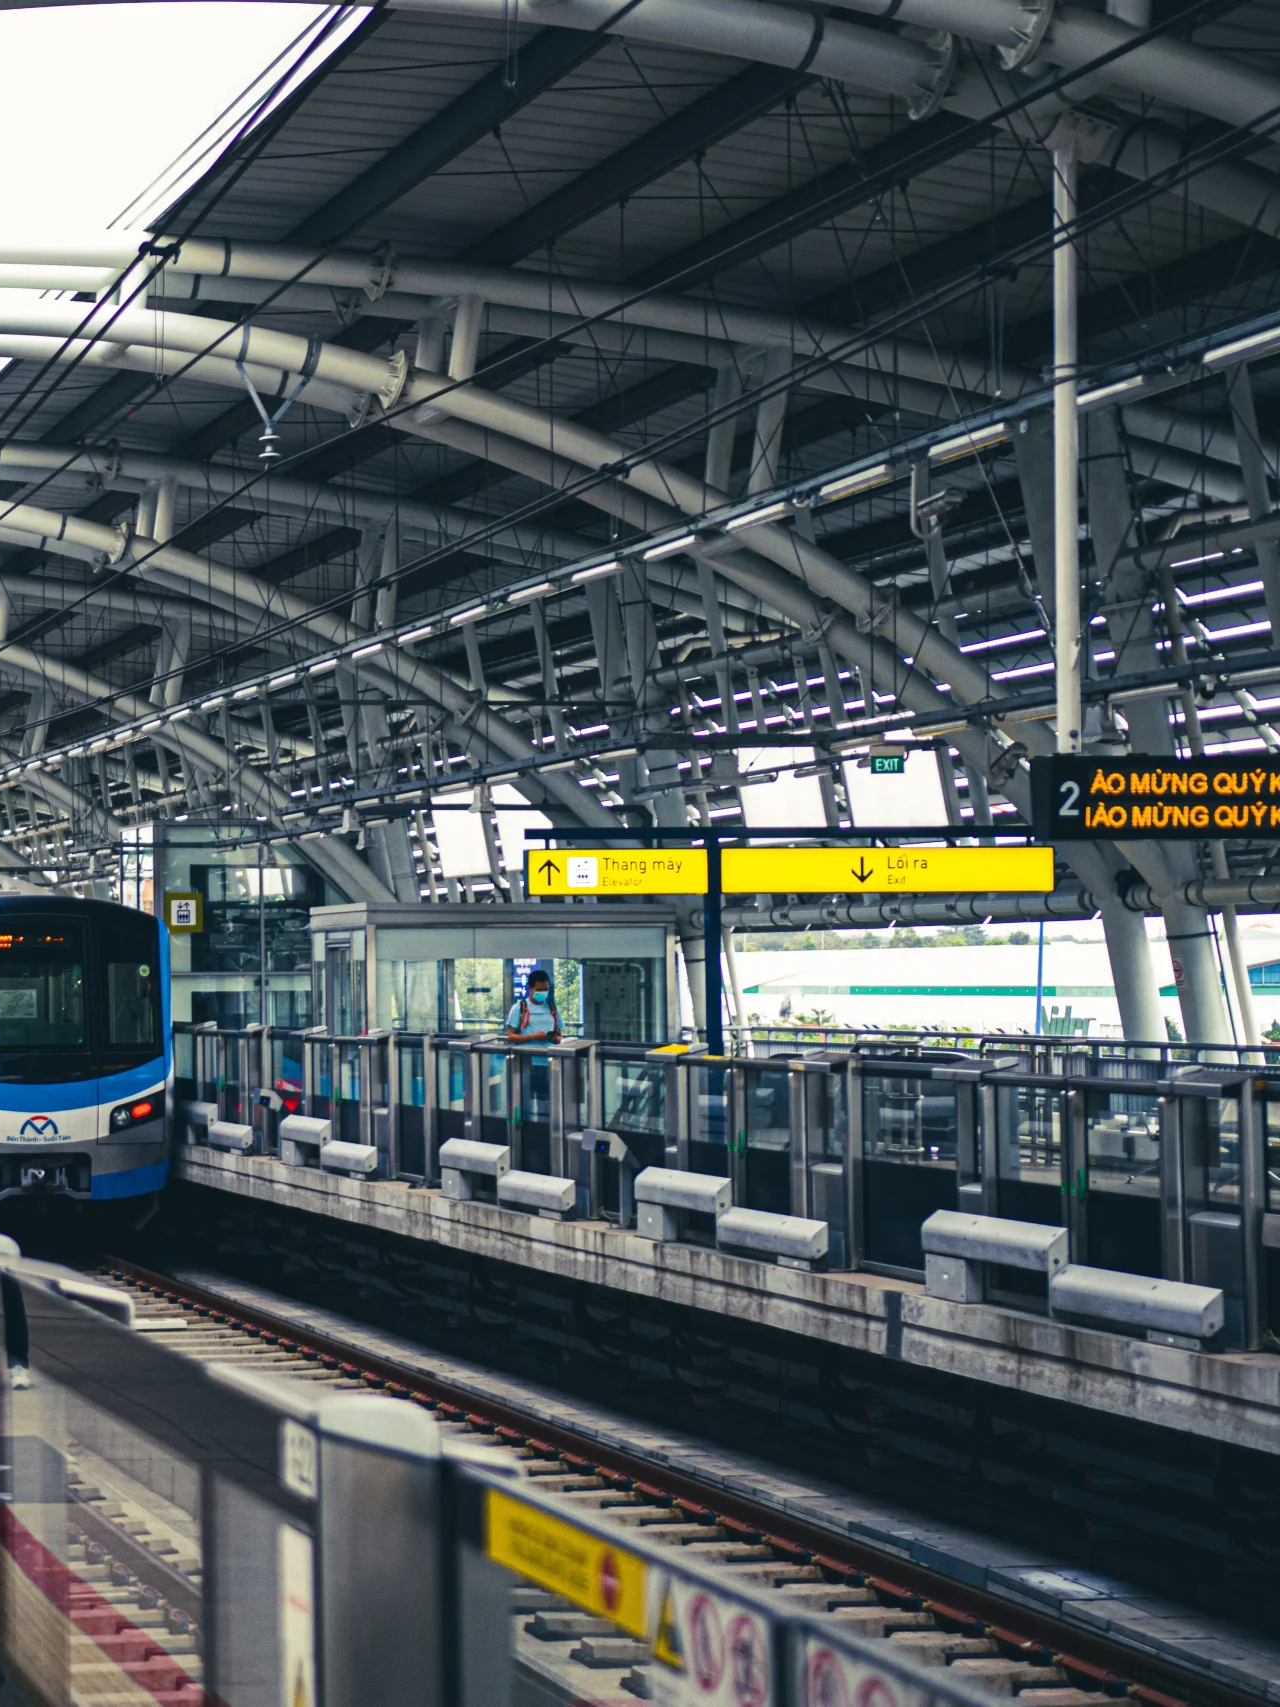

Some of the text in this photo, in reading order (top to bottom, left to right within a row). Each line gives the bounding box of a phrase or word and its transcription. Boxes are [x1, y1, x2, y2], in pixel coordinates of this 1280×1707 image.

[875, 758, 899, 771] EXIT
[1130, 769, 1208, 795] MỪNG
[1213, 768, 1266, 796] QUÝ
[1059, 781, 1080, 816] 2
[1131, 802, 1210, 828] MỪNG
[1214, 801, 1268, 828] QUÝ
[602, 857, 683, 874] Thang máy
[887, 854, 928, 869] Lối ra
[602, 877, 642, 887] Elevator
[887, 875, 906, 885] Exit
